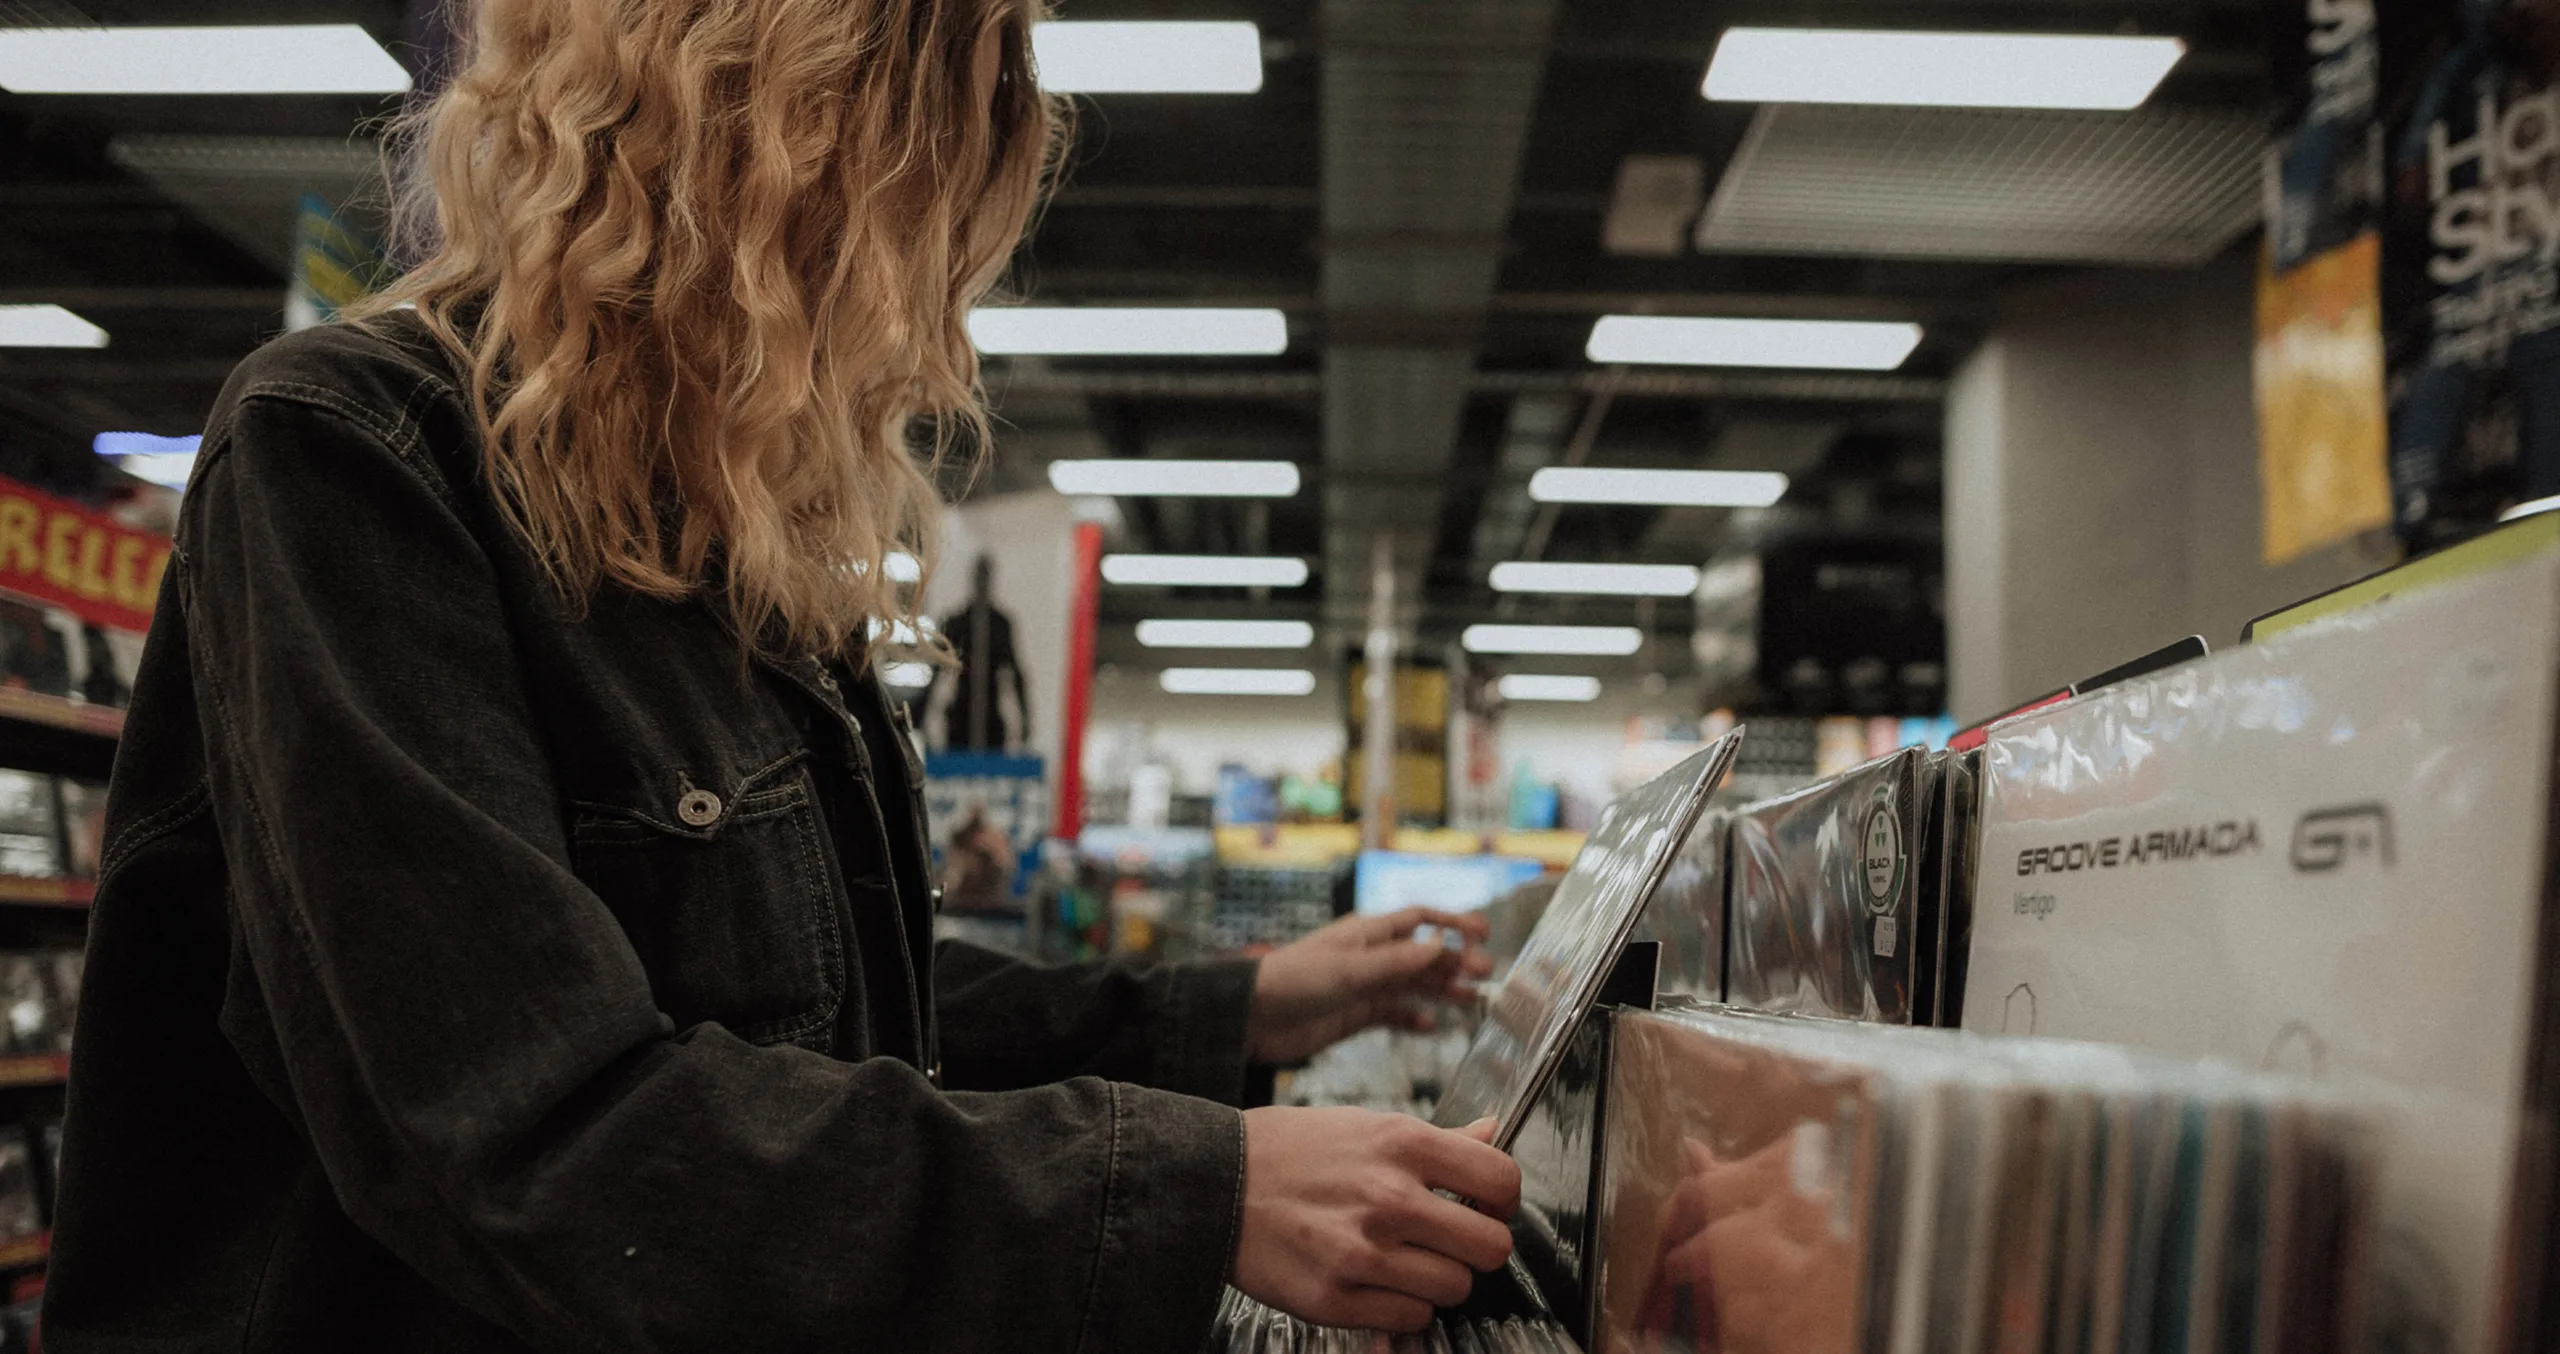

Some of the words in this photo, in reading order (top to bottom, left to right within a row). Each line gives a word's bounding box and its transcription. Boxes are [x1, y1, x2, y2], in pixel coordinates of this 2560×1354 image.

[2016, 837, 2120, 877] GROOVE
[2123, 819, 2264, 866] ARMADA
[1868, 857, 1892, 870] BLACK
[2013, 892, 2056, 920] Vertigo
